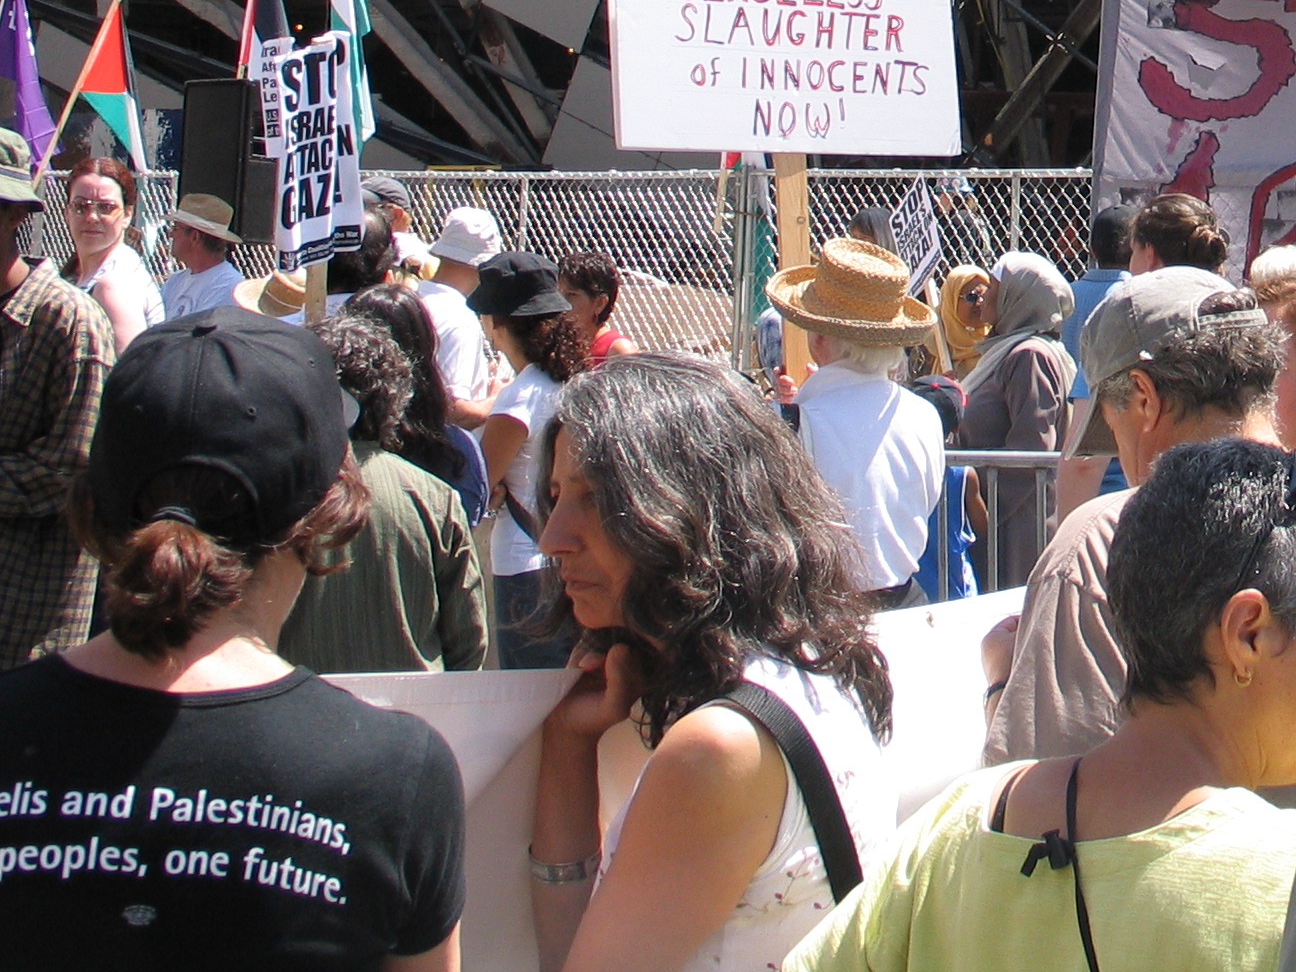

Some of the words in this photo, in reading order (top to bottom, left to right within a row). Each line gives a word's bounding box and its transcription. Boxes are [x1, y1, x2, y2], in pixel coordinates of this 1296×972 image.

[674, 3, 905, 52] SLAUGHTER
[741, 57, 930, 95] INNOCENTS
[753, 97, 847, 139] NOW!
[891, 177, 923, 238] STOP
[907, 229, 934, 275] AZA!
[61, 785, 136, 819] and
[149, 786, 350, 856] Palestinians,
[164, 849, 230, 876] one
[243, 847, 347, 905] future.
